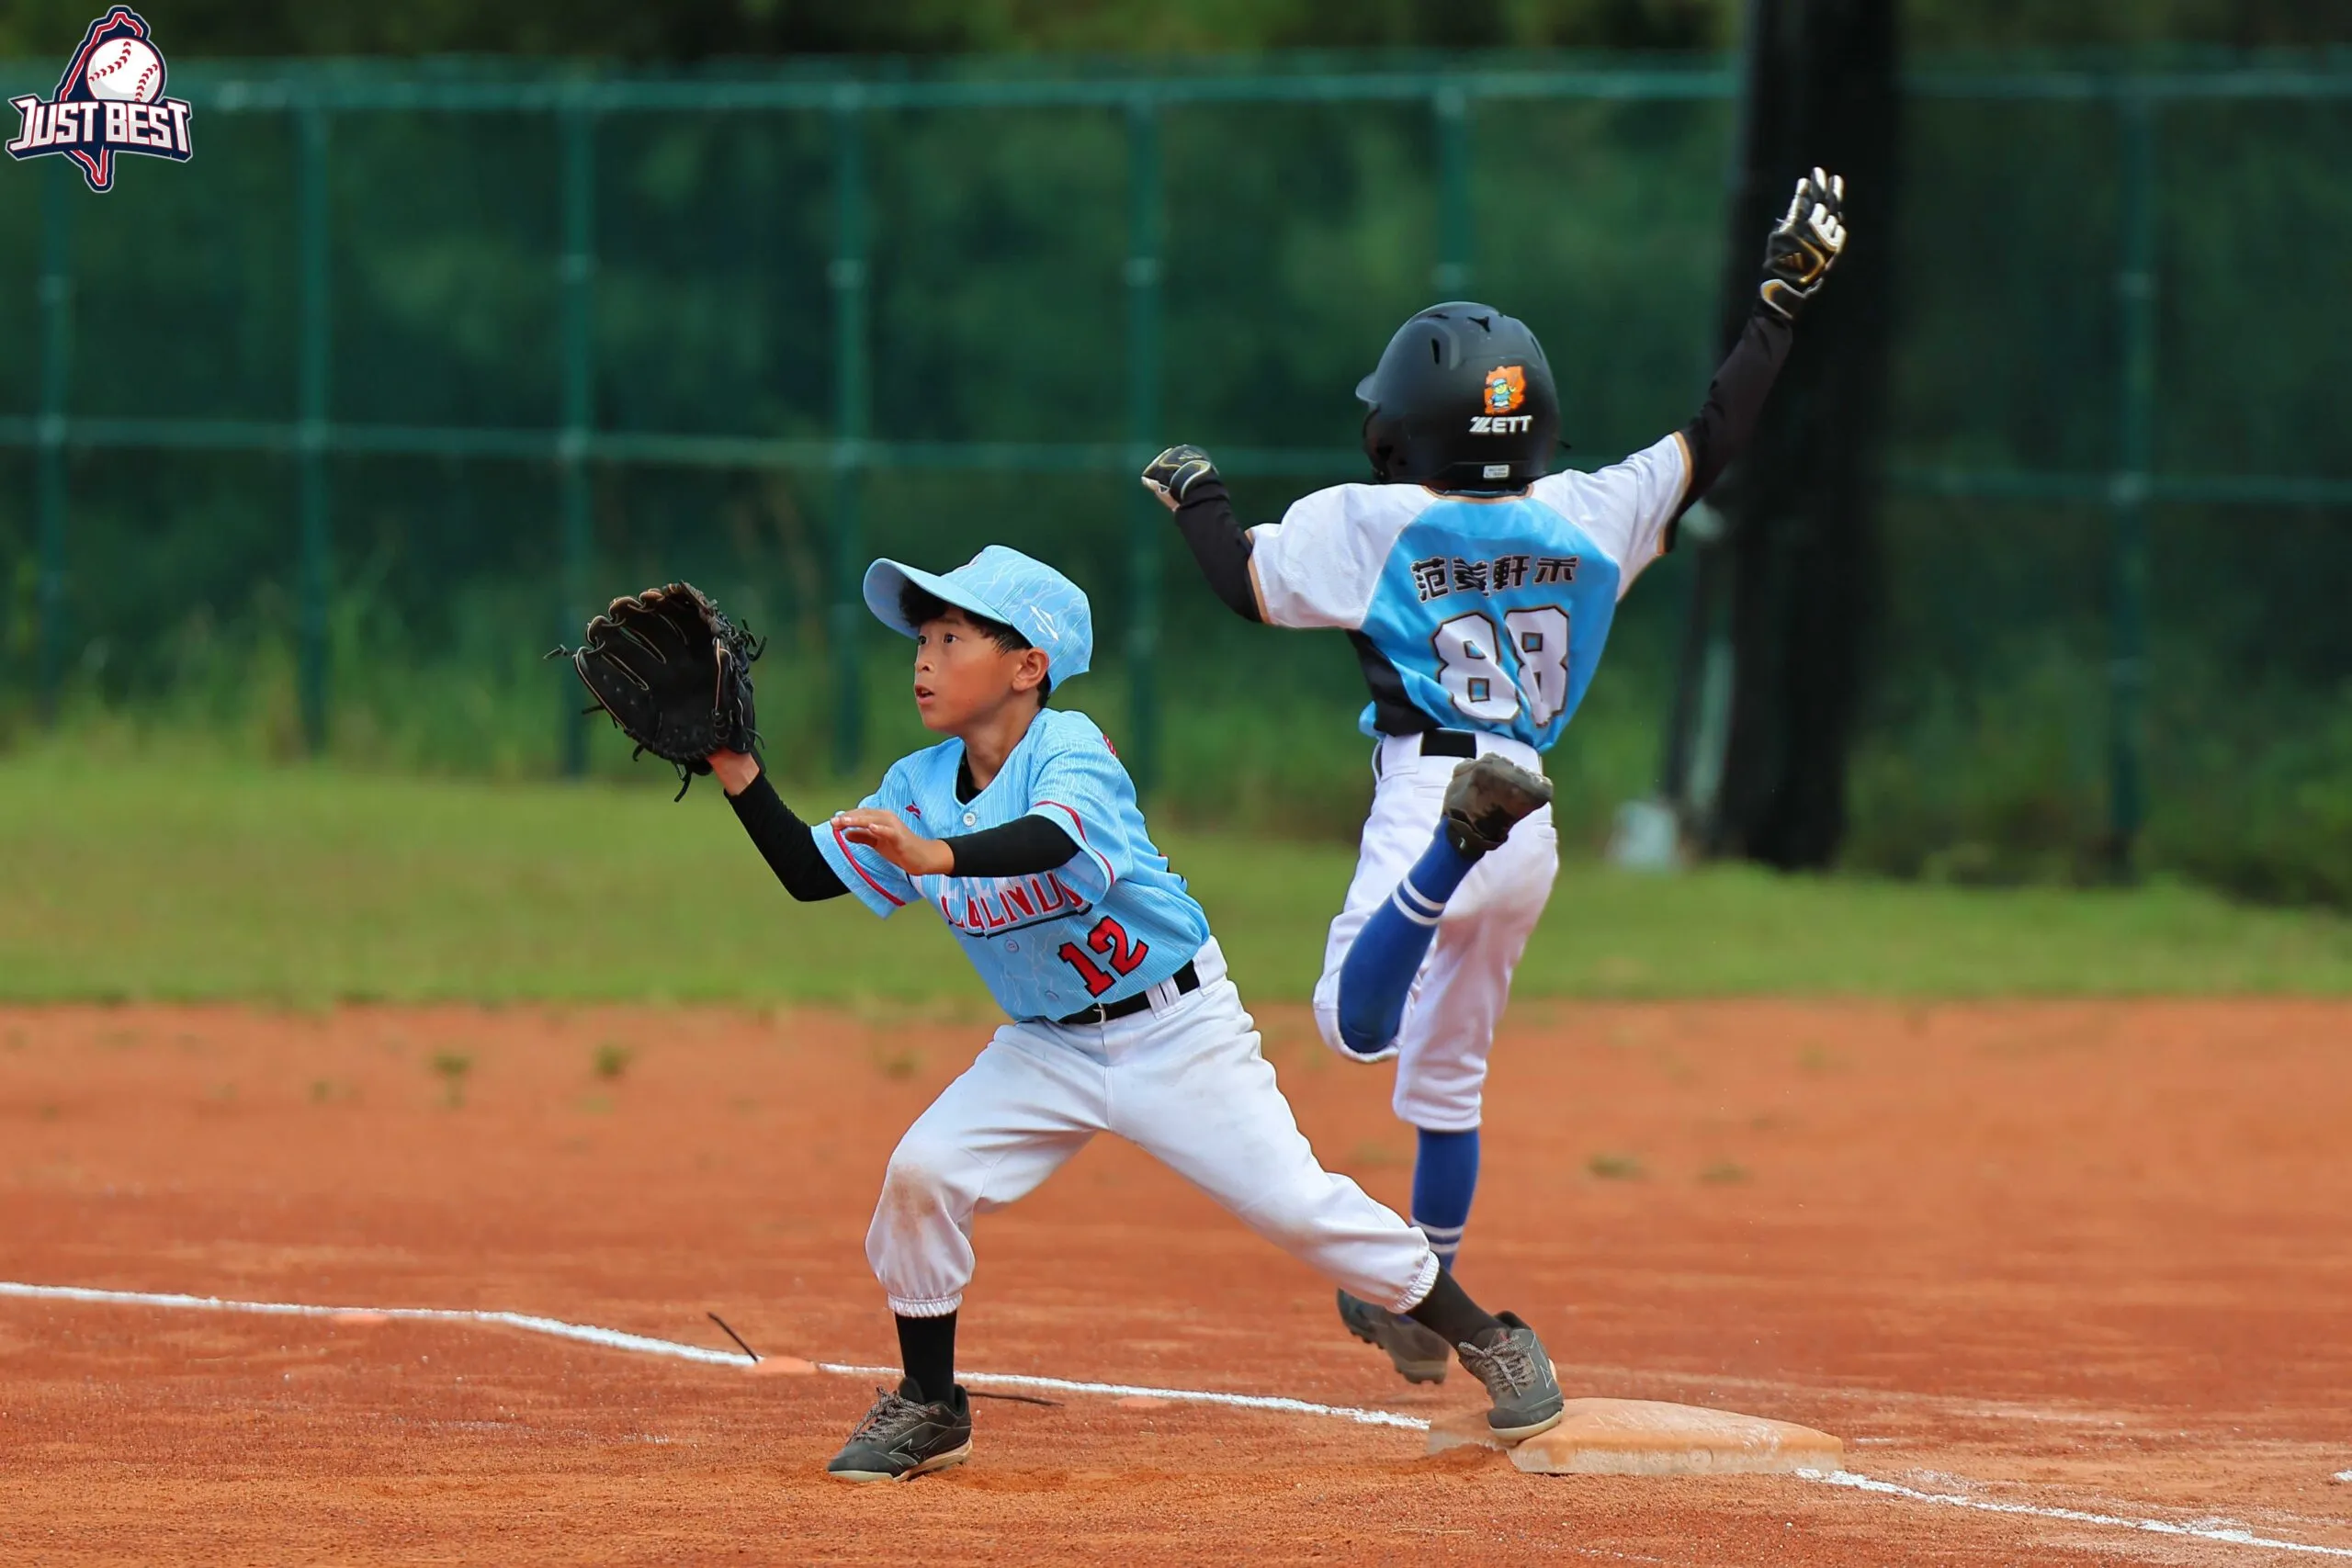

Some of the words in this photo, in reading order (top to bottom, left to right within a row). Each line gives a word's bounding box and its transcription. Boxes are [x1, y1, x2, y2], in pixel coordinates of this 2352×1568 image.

[1469, 415, 1532, 434] ZETT
[1430, 604, 1570, 728] 88
[1057, 915, 1148, 998] 12
